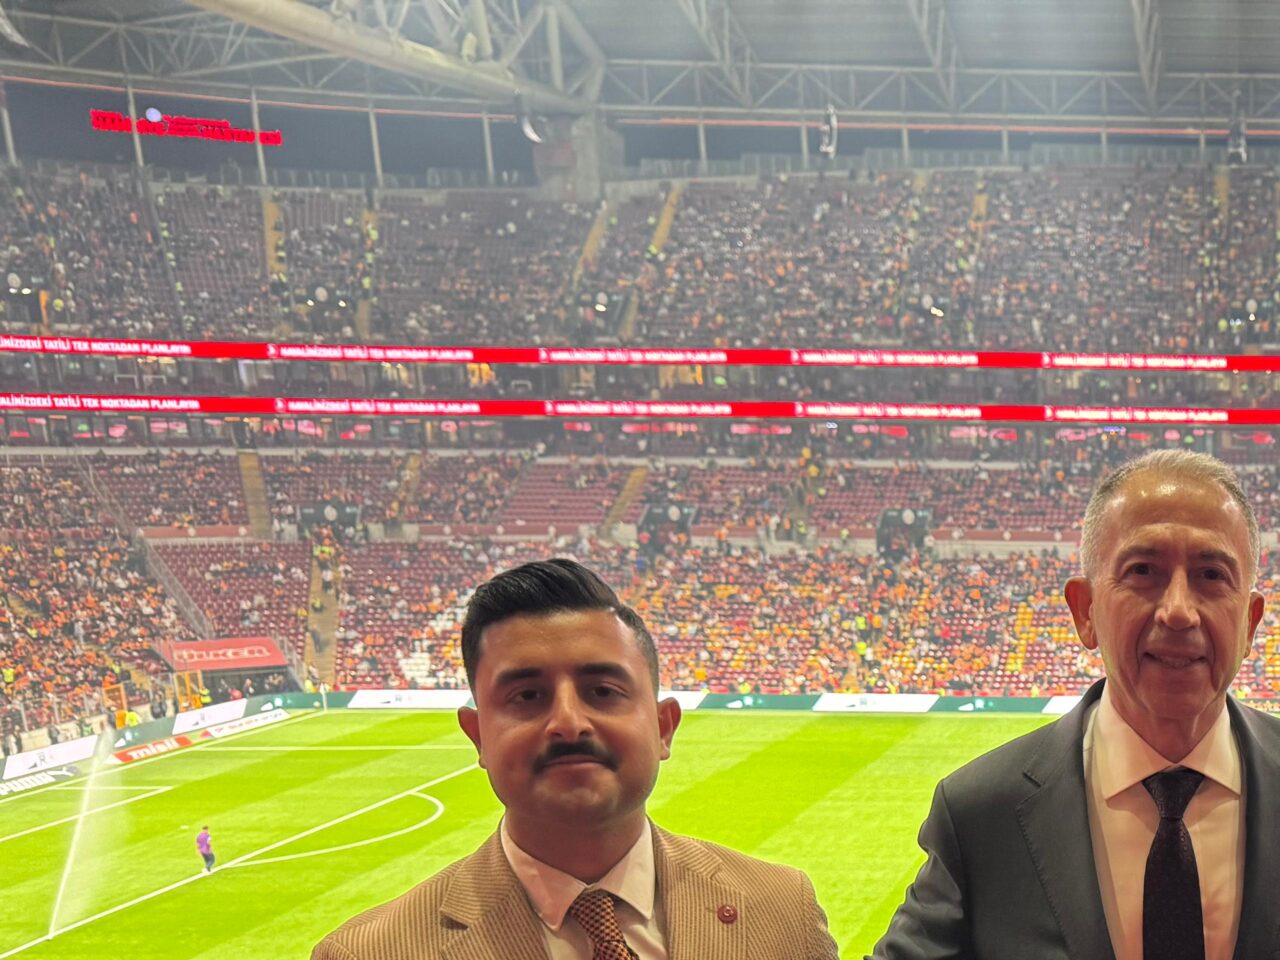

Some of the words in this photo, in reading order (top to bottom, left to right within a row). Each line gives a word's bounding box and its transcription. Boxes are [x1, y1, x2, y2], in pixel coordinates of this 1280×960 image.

[72, 340, 89, 351] TEK
[90, 342, 140, 353] NOKTADAN
[82, 398, 100, 408] TEK
